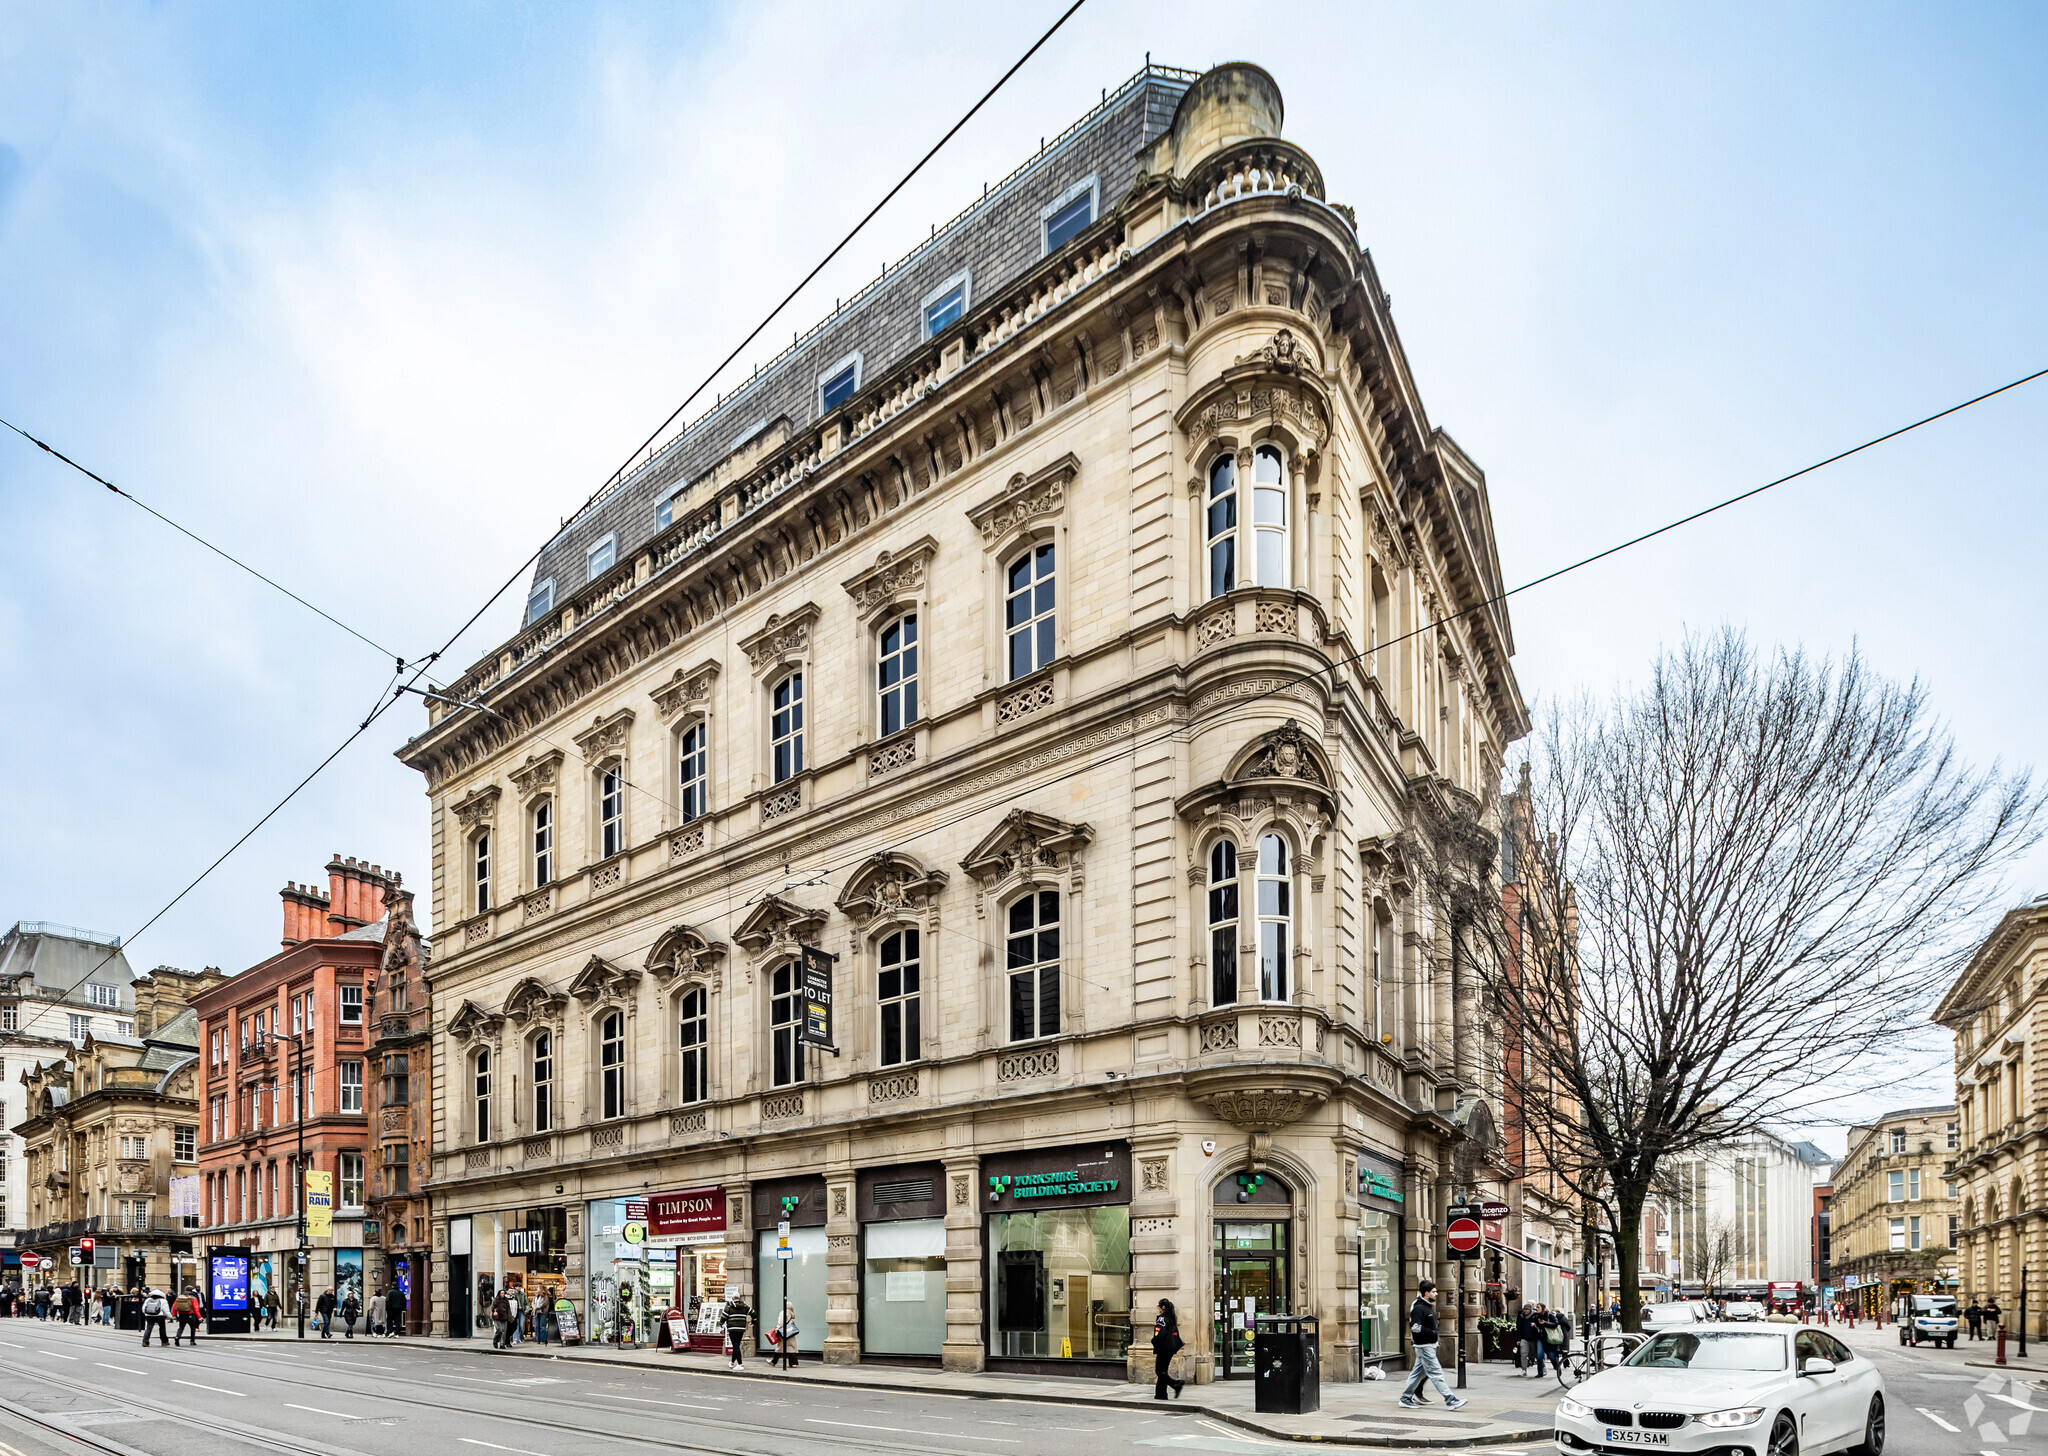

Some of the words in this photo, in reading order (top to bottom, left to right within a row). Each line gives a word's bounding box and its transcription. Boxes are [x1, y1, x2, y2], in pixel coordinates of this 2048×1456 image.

[803, 985, 816, 999] TO
[817, 990, 831, 1004] LET
[1014, 1170, 1079, 1186] YORKSHIRE
[1014, 1184, 1066, 1199] BUILDING
[1067, 1179, 1118, 1194] SOCIETY
[308, 1196, 330, 1206] RAIN
[657, 1198, 713, 1215] TIMPSON
[509, 1230, 544, 1254] UTILITY
[1612, 1430, 1641, 1442] SX57
[1643, 1432, 1667, 1444] SAM
